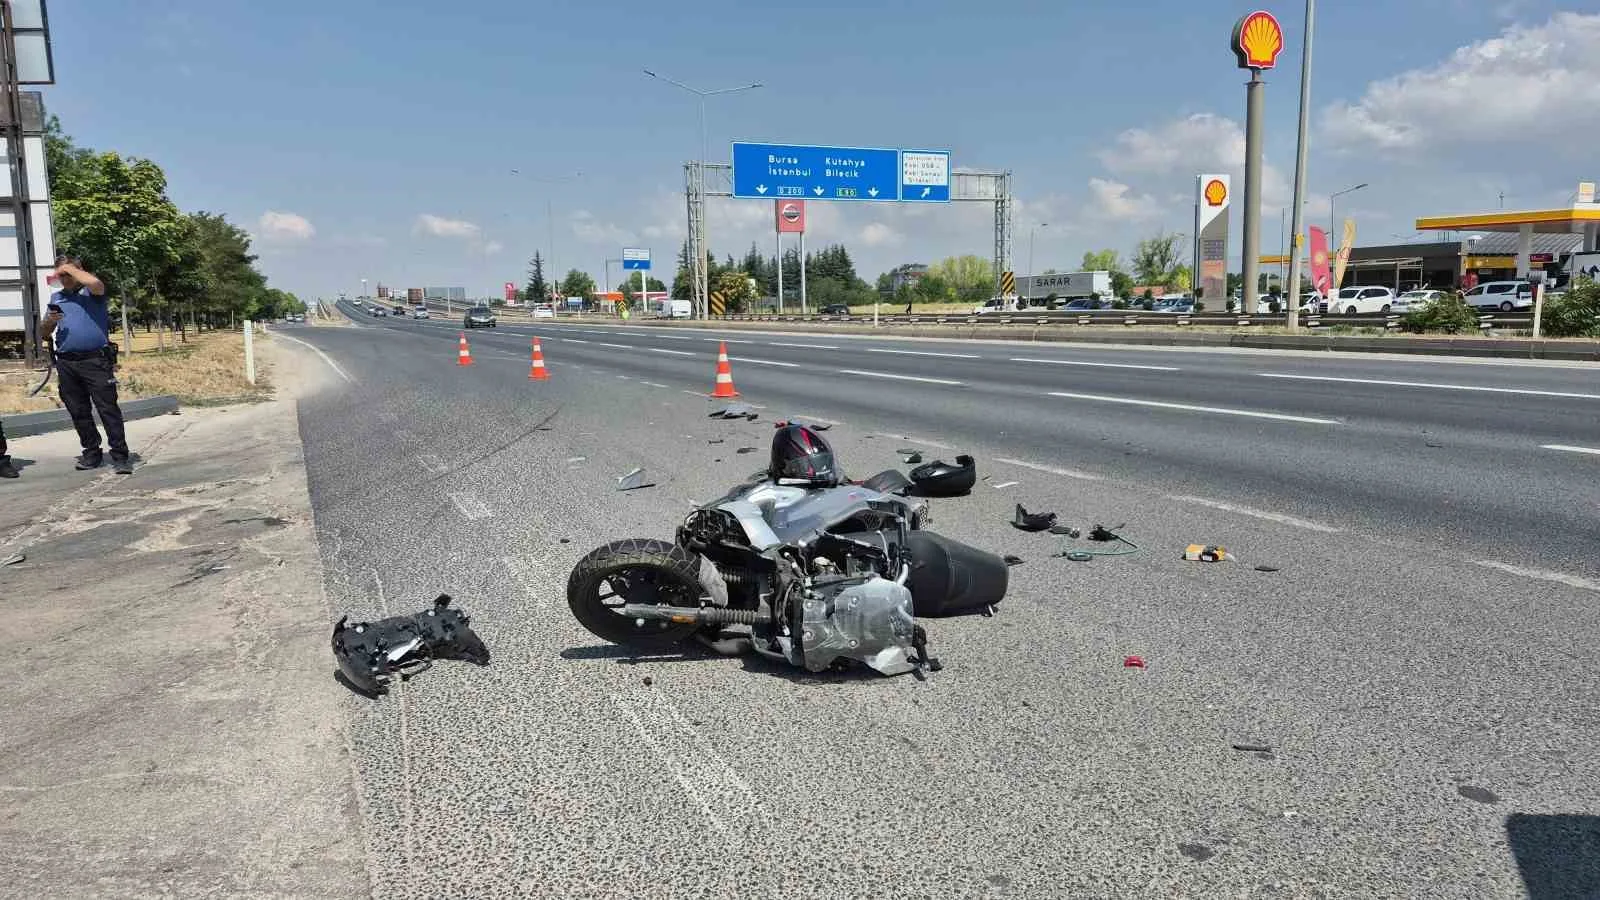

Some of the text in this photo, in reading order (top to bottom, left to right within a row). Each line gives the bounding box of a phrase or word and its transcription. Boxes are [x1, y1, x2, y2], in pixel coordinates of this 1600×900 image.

[768, 155, 798, 164] Bursa
[768, 165, 811, 176] İstanbul
[825, 169, 859, 177] Bilecik
[1036, 277, 1072, 287] SARAR
